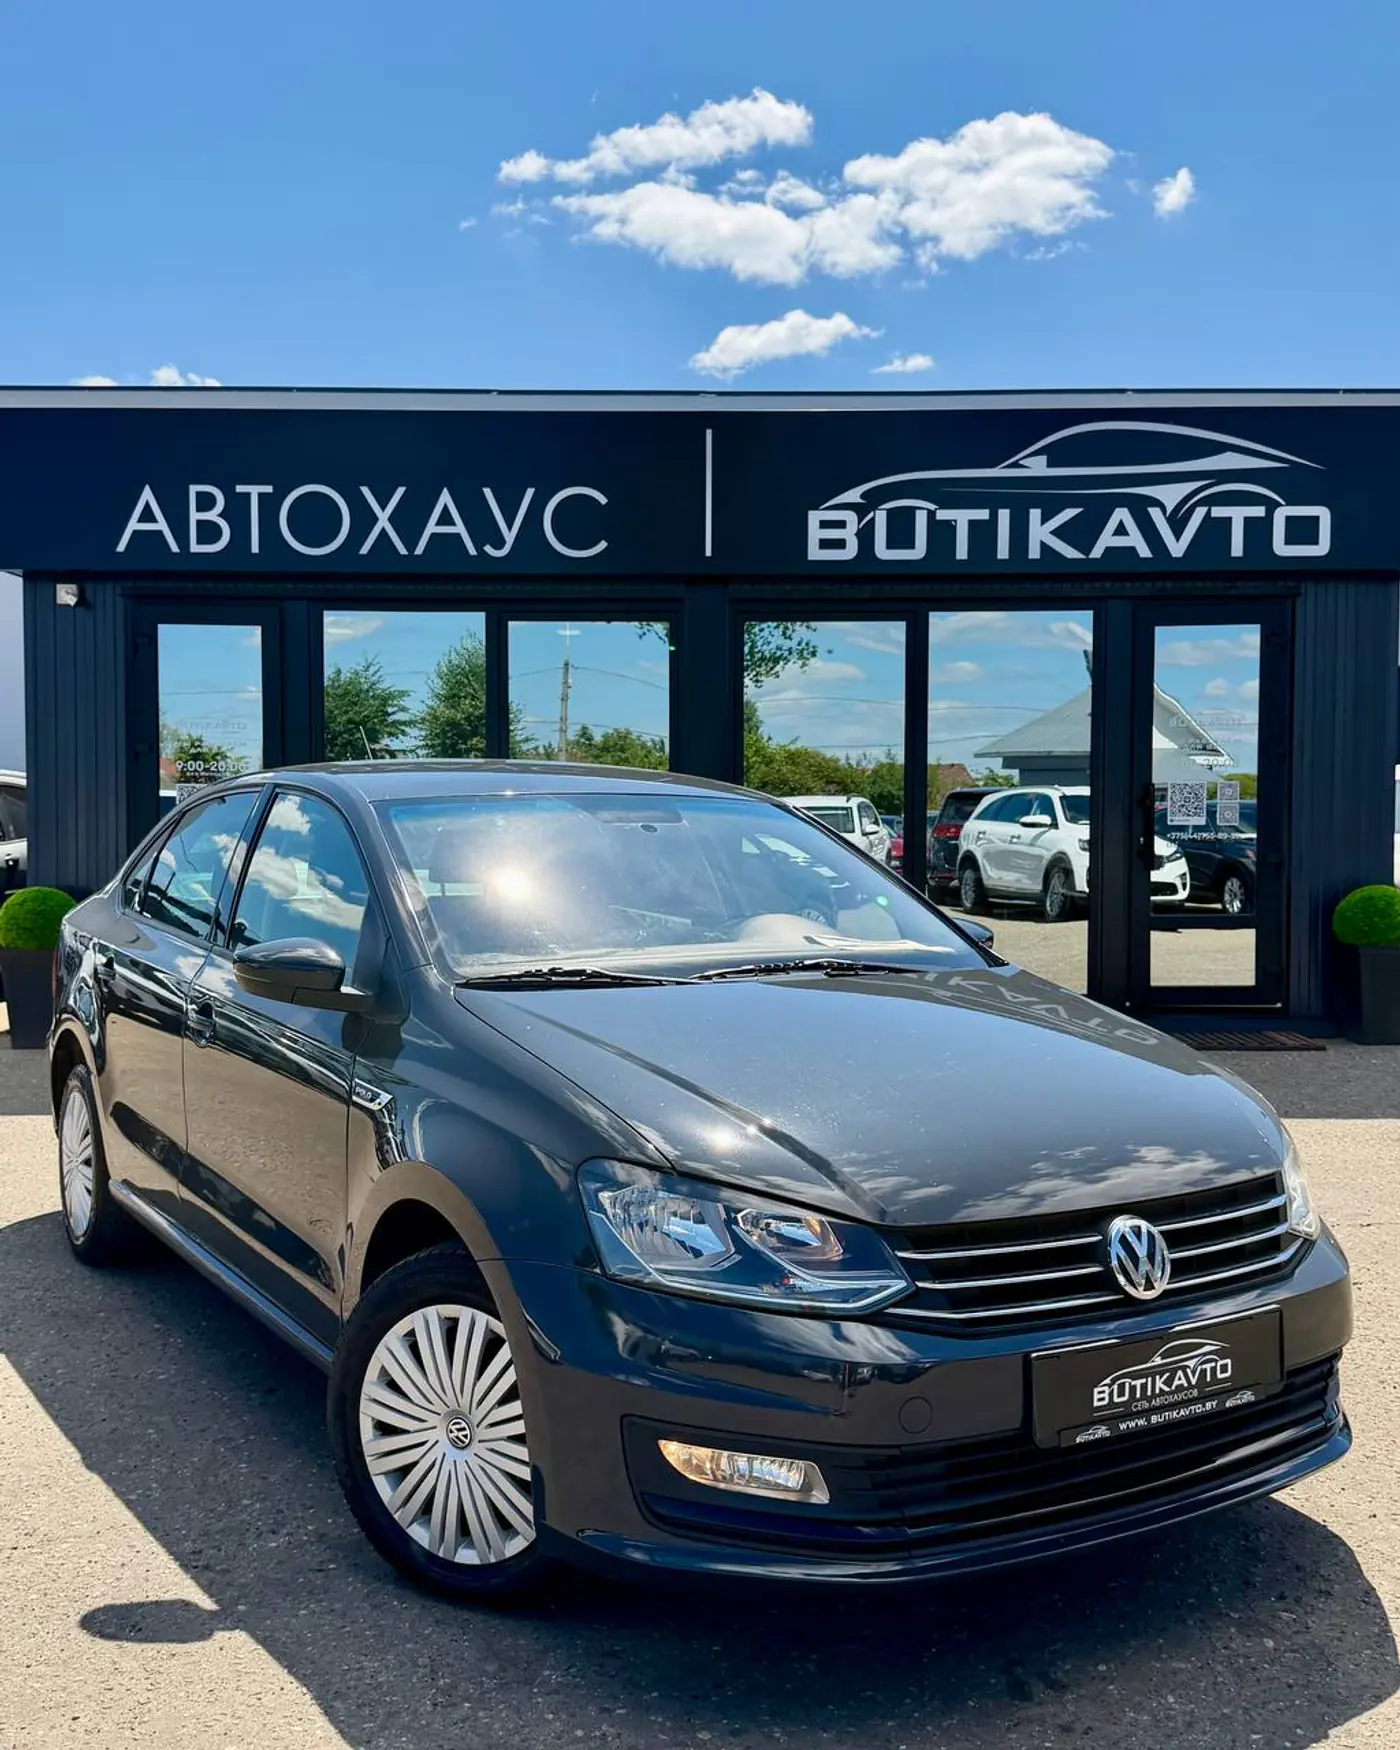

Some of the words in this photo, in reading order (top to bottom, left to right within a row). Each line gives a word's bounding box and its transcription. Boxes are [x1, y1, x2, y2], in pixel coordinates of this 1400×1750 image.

[115, 484, 609, 559] АВТОХАУС
[807, 505, 1332, 561] BUTIKAVTO
[1093, 1358, 1232, 1407] BUTIKAVTO
[1131, 1399, 1150, 1412] СЕТЬ
[1151, 1389, 1199, 1409] АВТОХАУСОВ
[1150, 1400, 1219, 1424] BUTIKAVTO.BY
